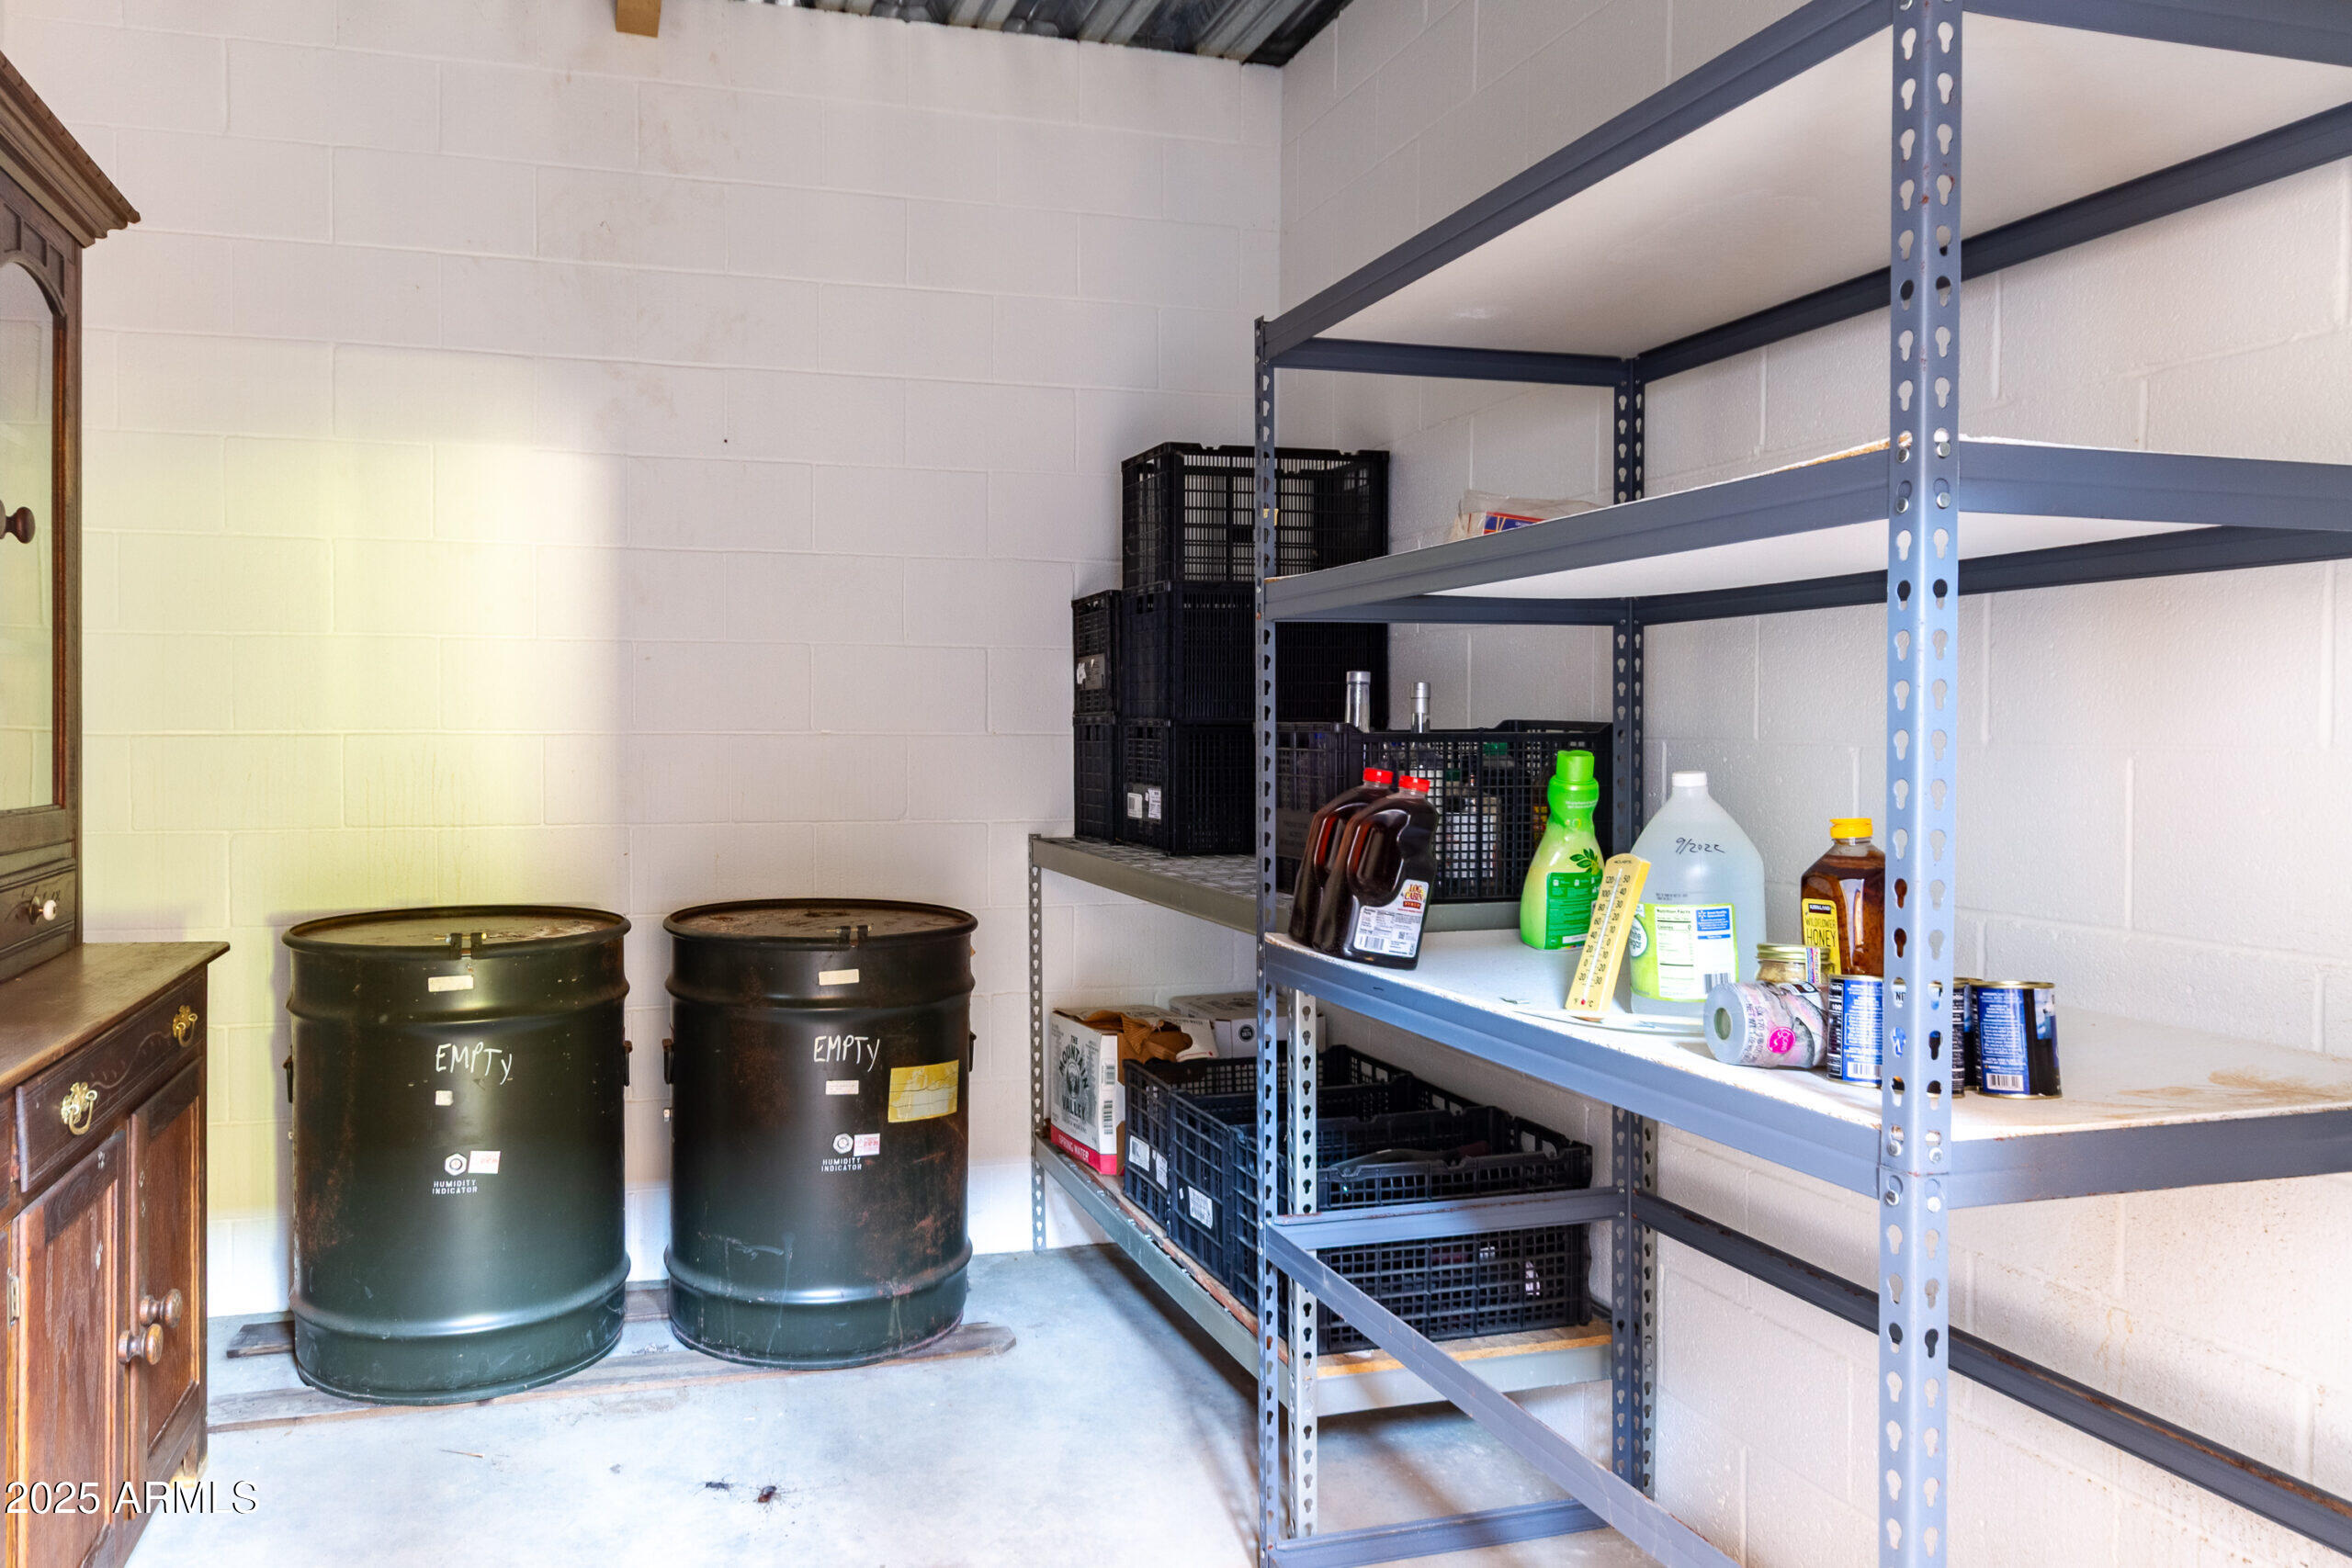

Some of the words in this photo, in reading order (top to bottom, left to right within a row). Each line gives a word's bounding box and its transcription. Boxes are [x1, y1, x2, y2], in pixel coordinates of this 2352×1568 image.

[1605, 875, 1615, 885] 120
[1623, 874, 1631, 884] 50
[1409, 884, 1423, 893] LOG
[1601, 889, 1611, 897] 100
[1620, 887, 1627, 896] 40
[1405, 891, 1423, 901] CABIN
[1616, 900, 1623, 909] 30
[1804, 918, 1836, 929] WILDFLOWER
[1806, 929, 1837, 947] HONEY
[1070, 1034, 1079, 1044] THE
[813, 1034, 880, 1073] EMPTY
[435, 1042, 513, 1085] EMPTY
[1058, 1043, 1089, 1089] MOUNTAIN
[1061, 1093, 1085, 1120] VALLEY
[1058, 1134, 1074, 1152] SPRING
[1074, 1145, 1090, 1162] WATER
[434, 1179, 476, 1187] HUMIDITY
[432, 1186, 478, 1195] INDICATOR
